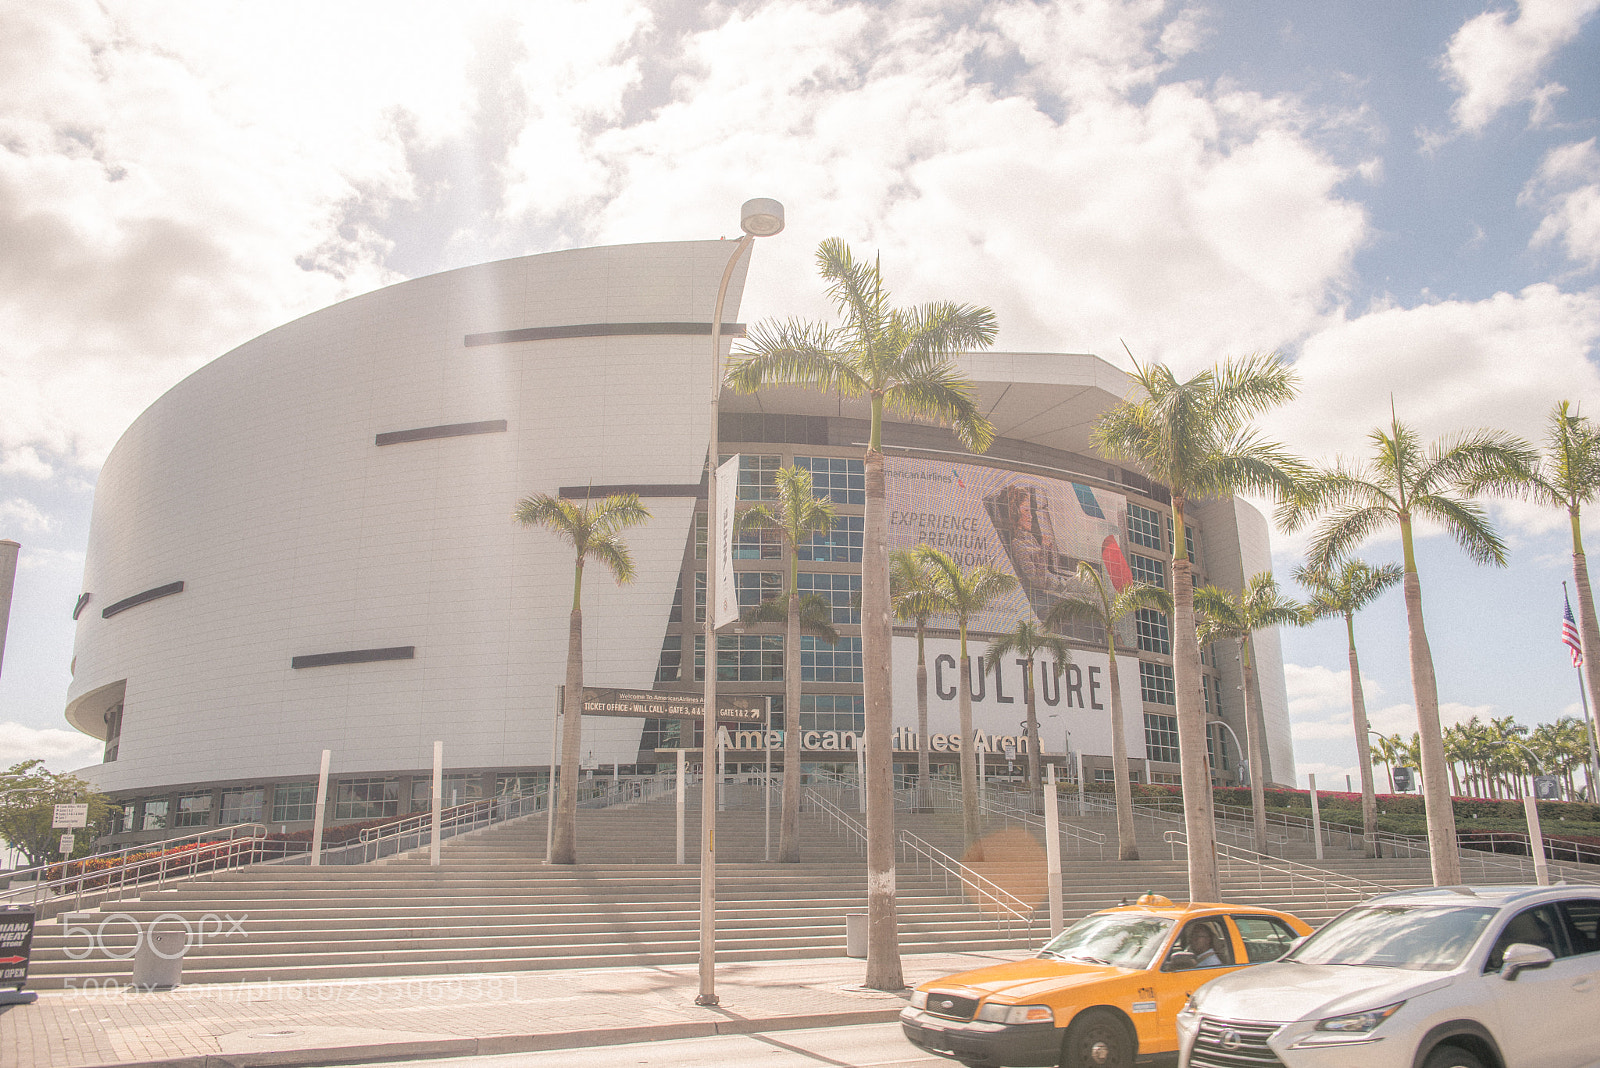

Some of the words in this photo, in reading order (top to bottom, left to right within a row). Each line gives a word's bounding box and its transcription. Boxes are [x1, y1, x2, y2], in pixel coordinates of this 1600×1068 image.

[891, 510, 978, 532] EXPERIENCE
[919, 530, 987, 550] PREMIUM
[934, 653, 1104, 710] CULTURE
[619, 692, 645, 700] Welcome
[584, 702, 606, 711] TICKET
[606, 703, 628, 712] OFFICE
[633, 704, 648, 713] WILL
[648, 705, 664, 714] CALL
[668, 706, 683, 714] GATE
[720, 708, 734, 716] GATE
[744, 709, 749, 717] 2
[0, 928, 31, 941] HEAT
[4, 968, 26, 979] OPEN
